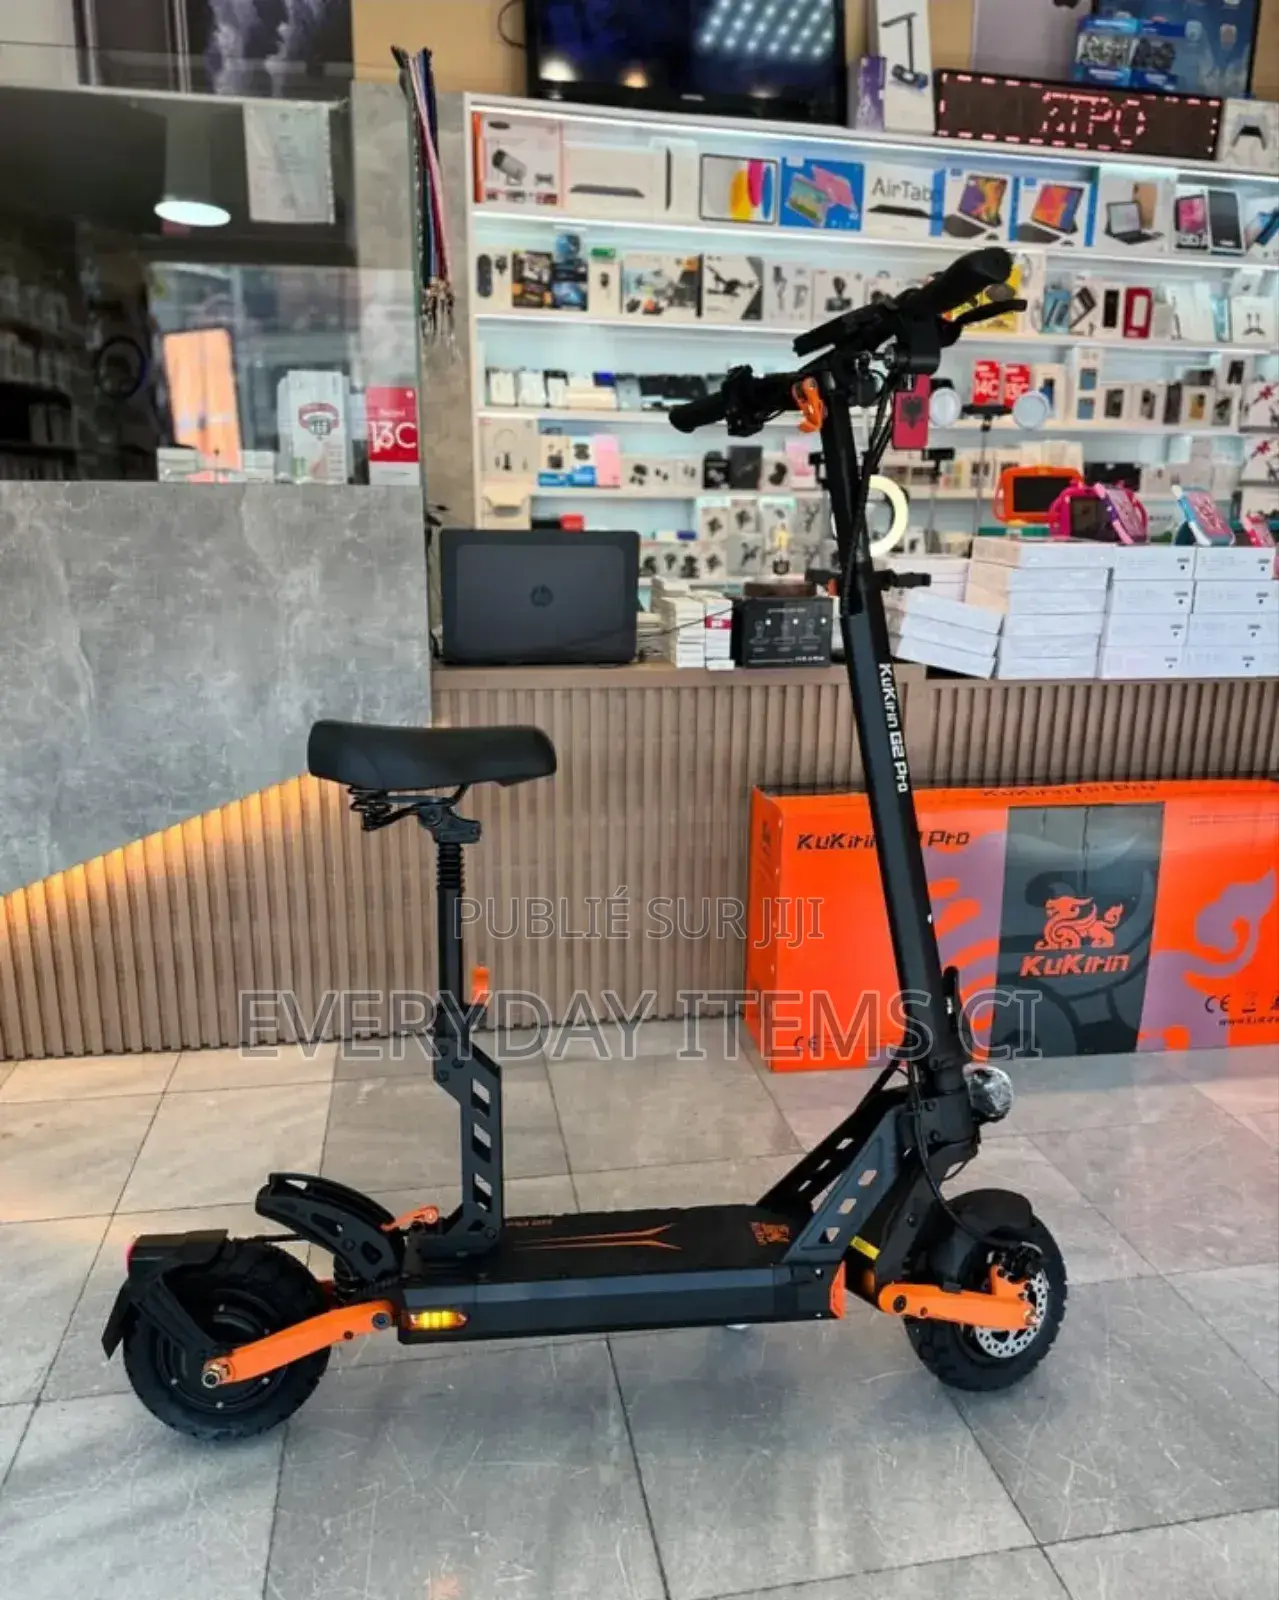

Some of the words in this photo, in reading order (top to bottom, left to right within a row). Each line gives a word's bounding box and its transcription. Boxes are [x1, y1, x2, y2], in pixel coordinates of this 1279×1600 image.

[878, 662, 899, 729] KuKirin
[893, 760, 909, 793] Pro
[927, 829, 971, 847] Pro
[1020, 953, 1130, 977] KuKirin
